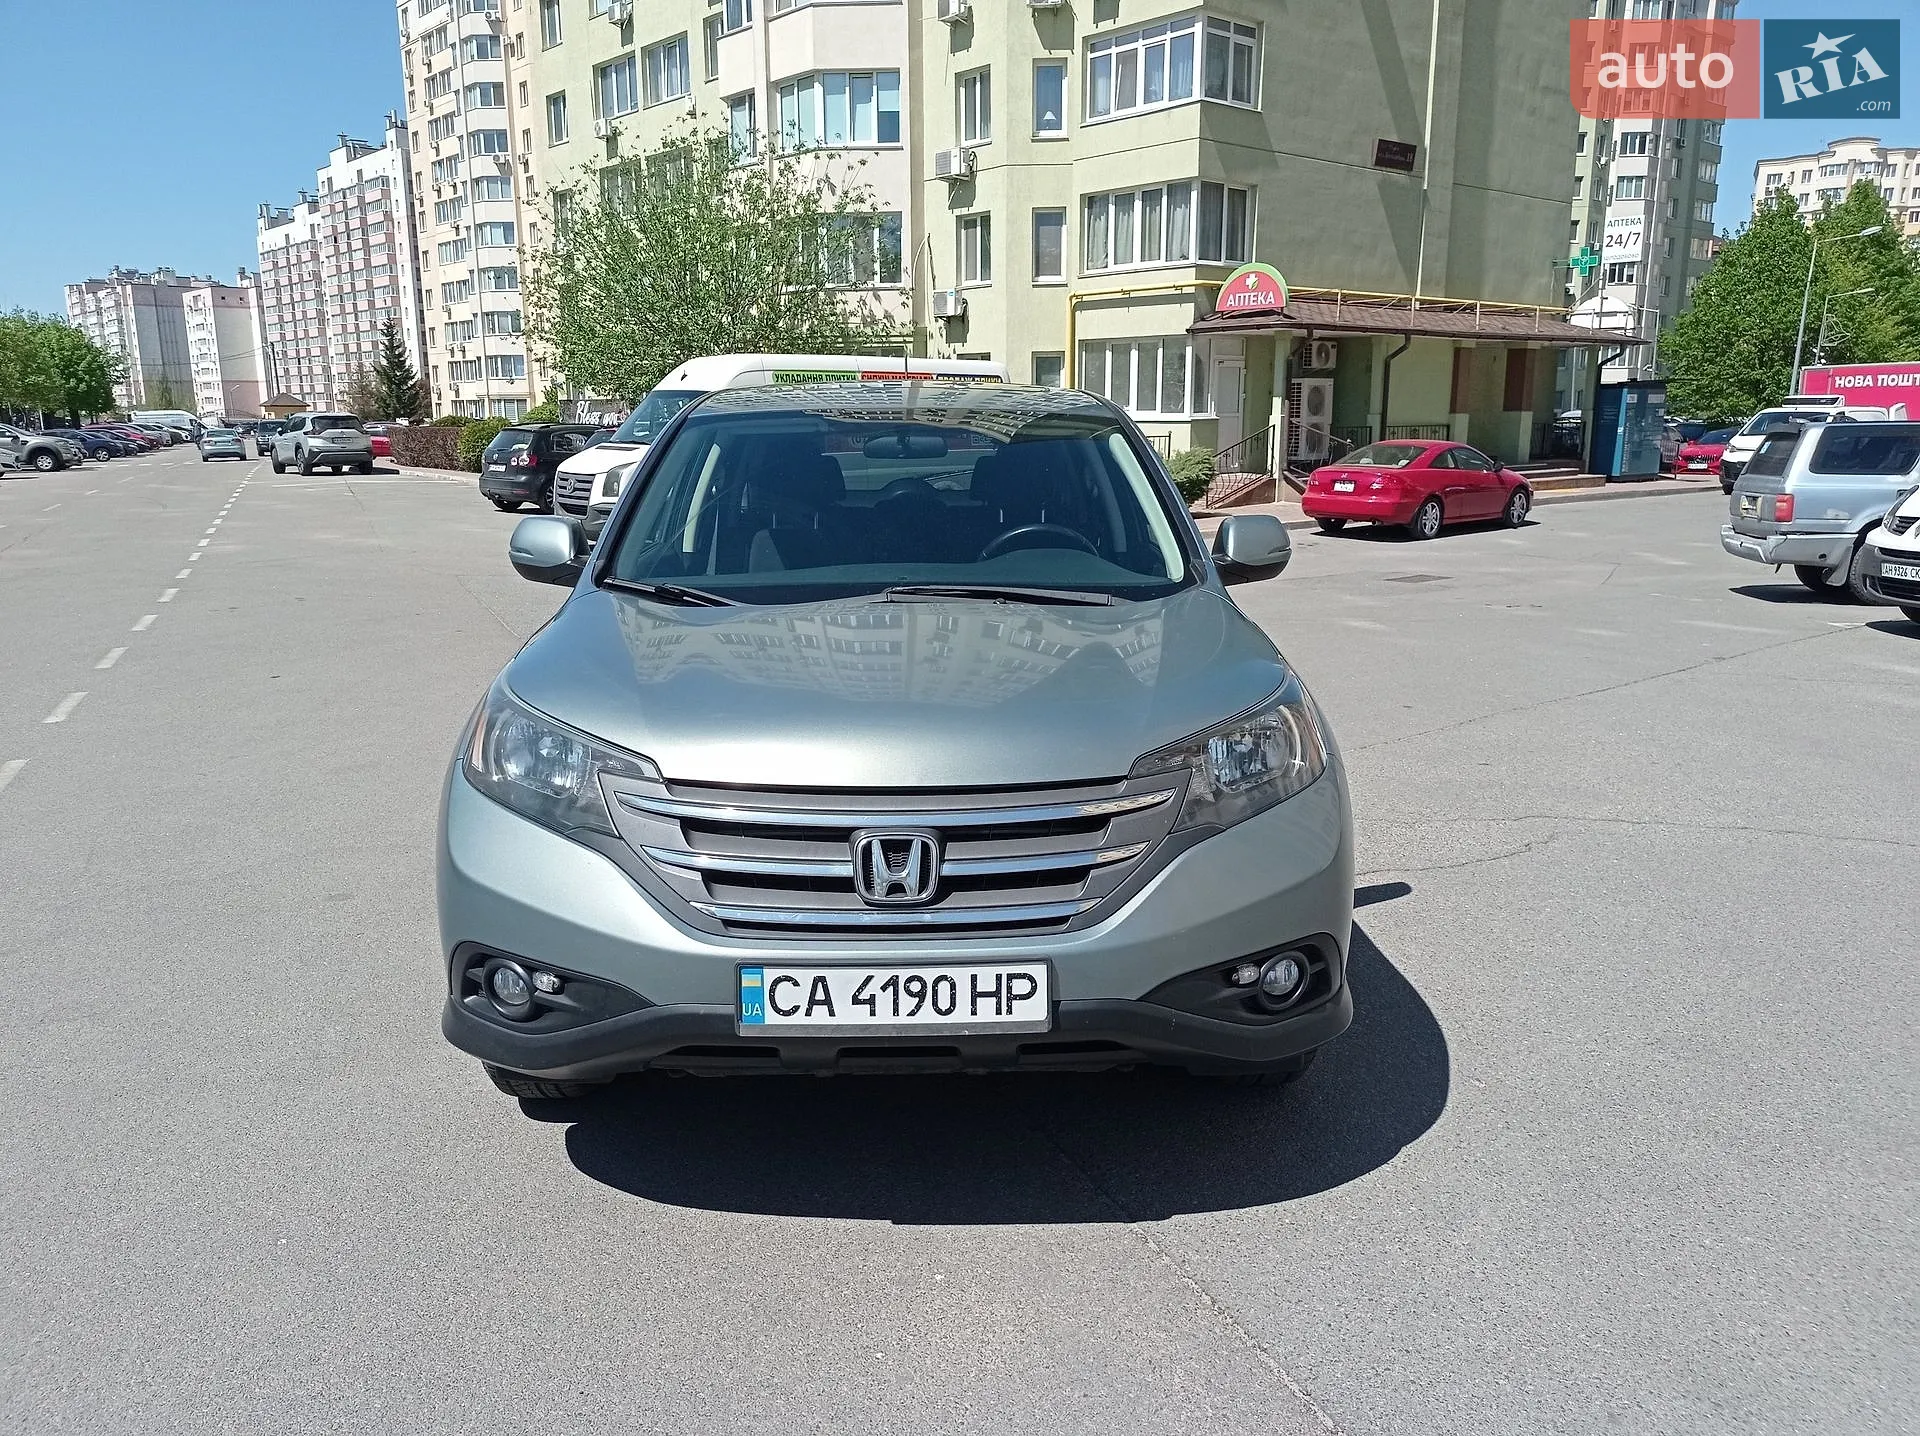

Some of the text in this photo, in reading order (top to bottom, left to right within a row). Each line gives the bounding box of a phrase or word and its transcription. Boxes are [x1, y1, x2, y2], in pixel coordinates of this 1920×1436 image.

[1607, 217, 1642, 228] АПТЕКА
[1605, 231, 1641, 249] 24/7
[1226, 290, 1275, 307] АПТЕКА
[774, 373, 823, 384] УКЛАДАННЯ
[1834, 373, 1920, 389] НОВА ПОШТ
[575, 400, 602, 424] Bless
[1894, 565, 1908, 577] 9326
[768, 972, 1039, 1017] CA 4190 HP
[742, 1002, 763, 1017] UA
